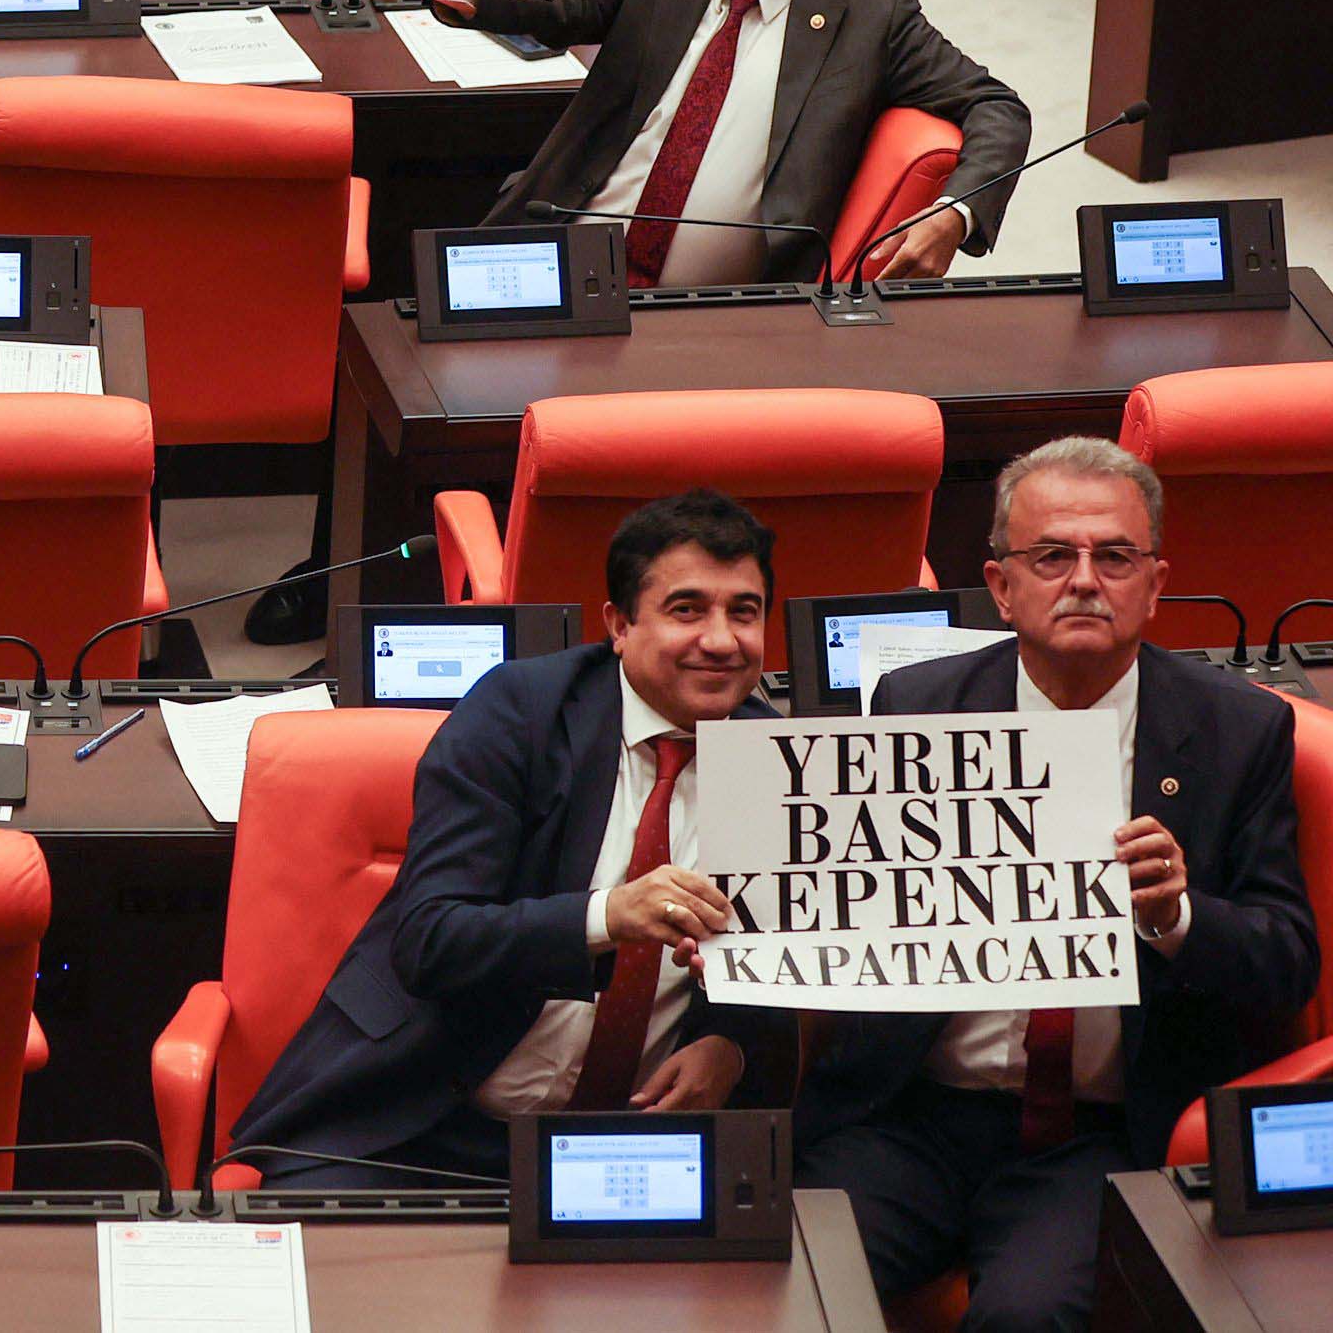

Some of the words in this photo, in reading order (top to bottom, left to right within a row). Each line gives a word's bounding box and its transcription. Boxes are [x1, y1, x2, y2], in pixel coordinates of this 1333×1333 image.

[771, 729, 1051, 797] YEREL
[782, 796, 1044, 866] BASIN
[708, 859, 1127, 934] KEPENEK
[717, 931, 1120, 987] KAPATACAK!
